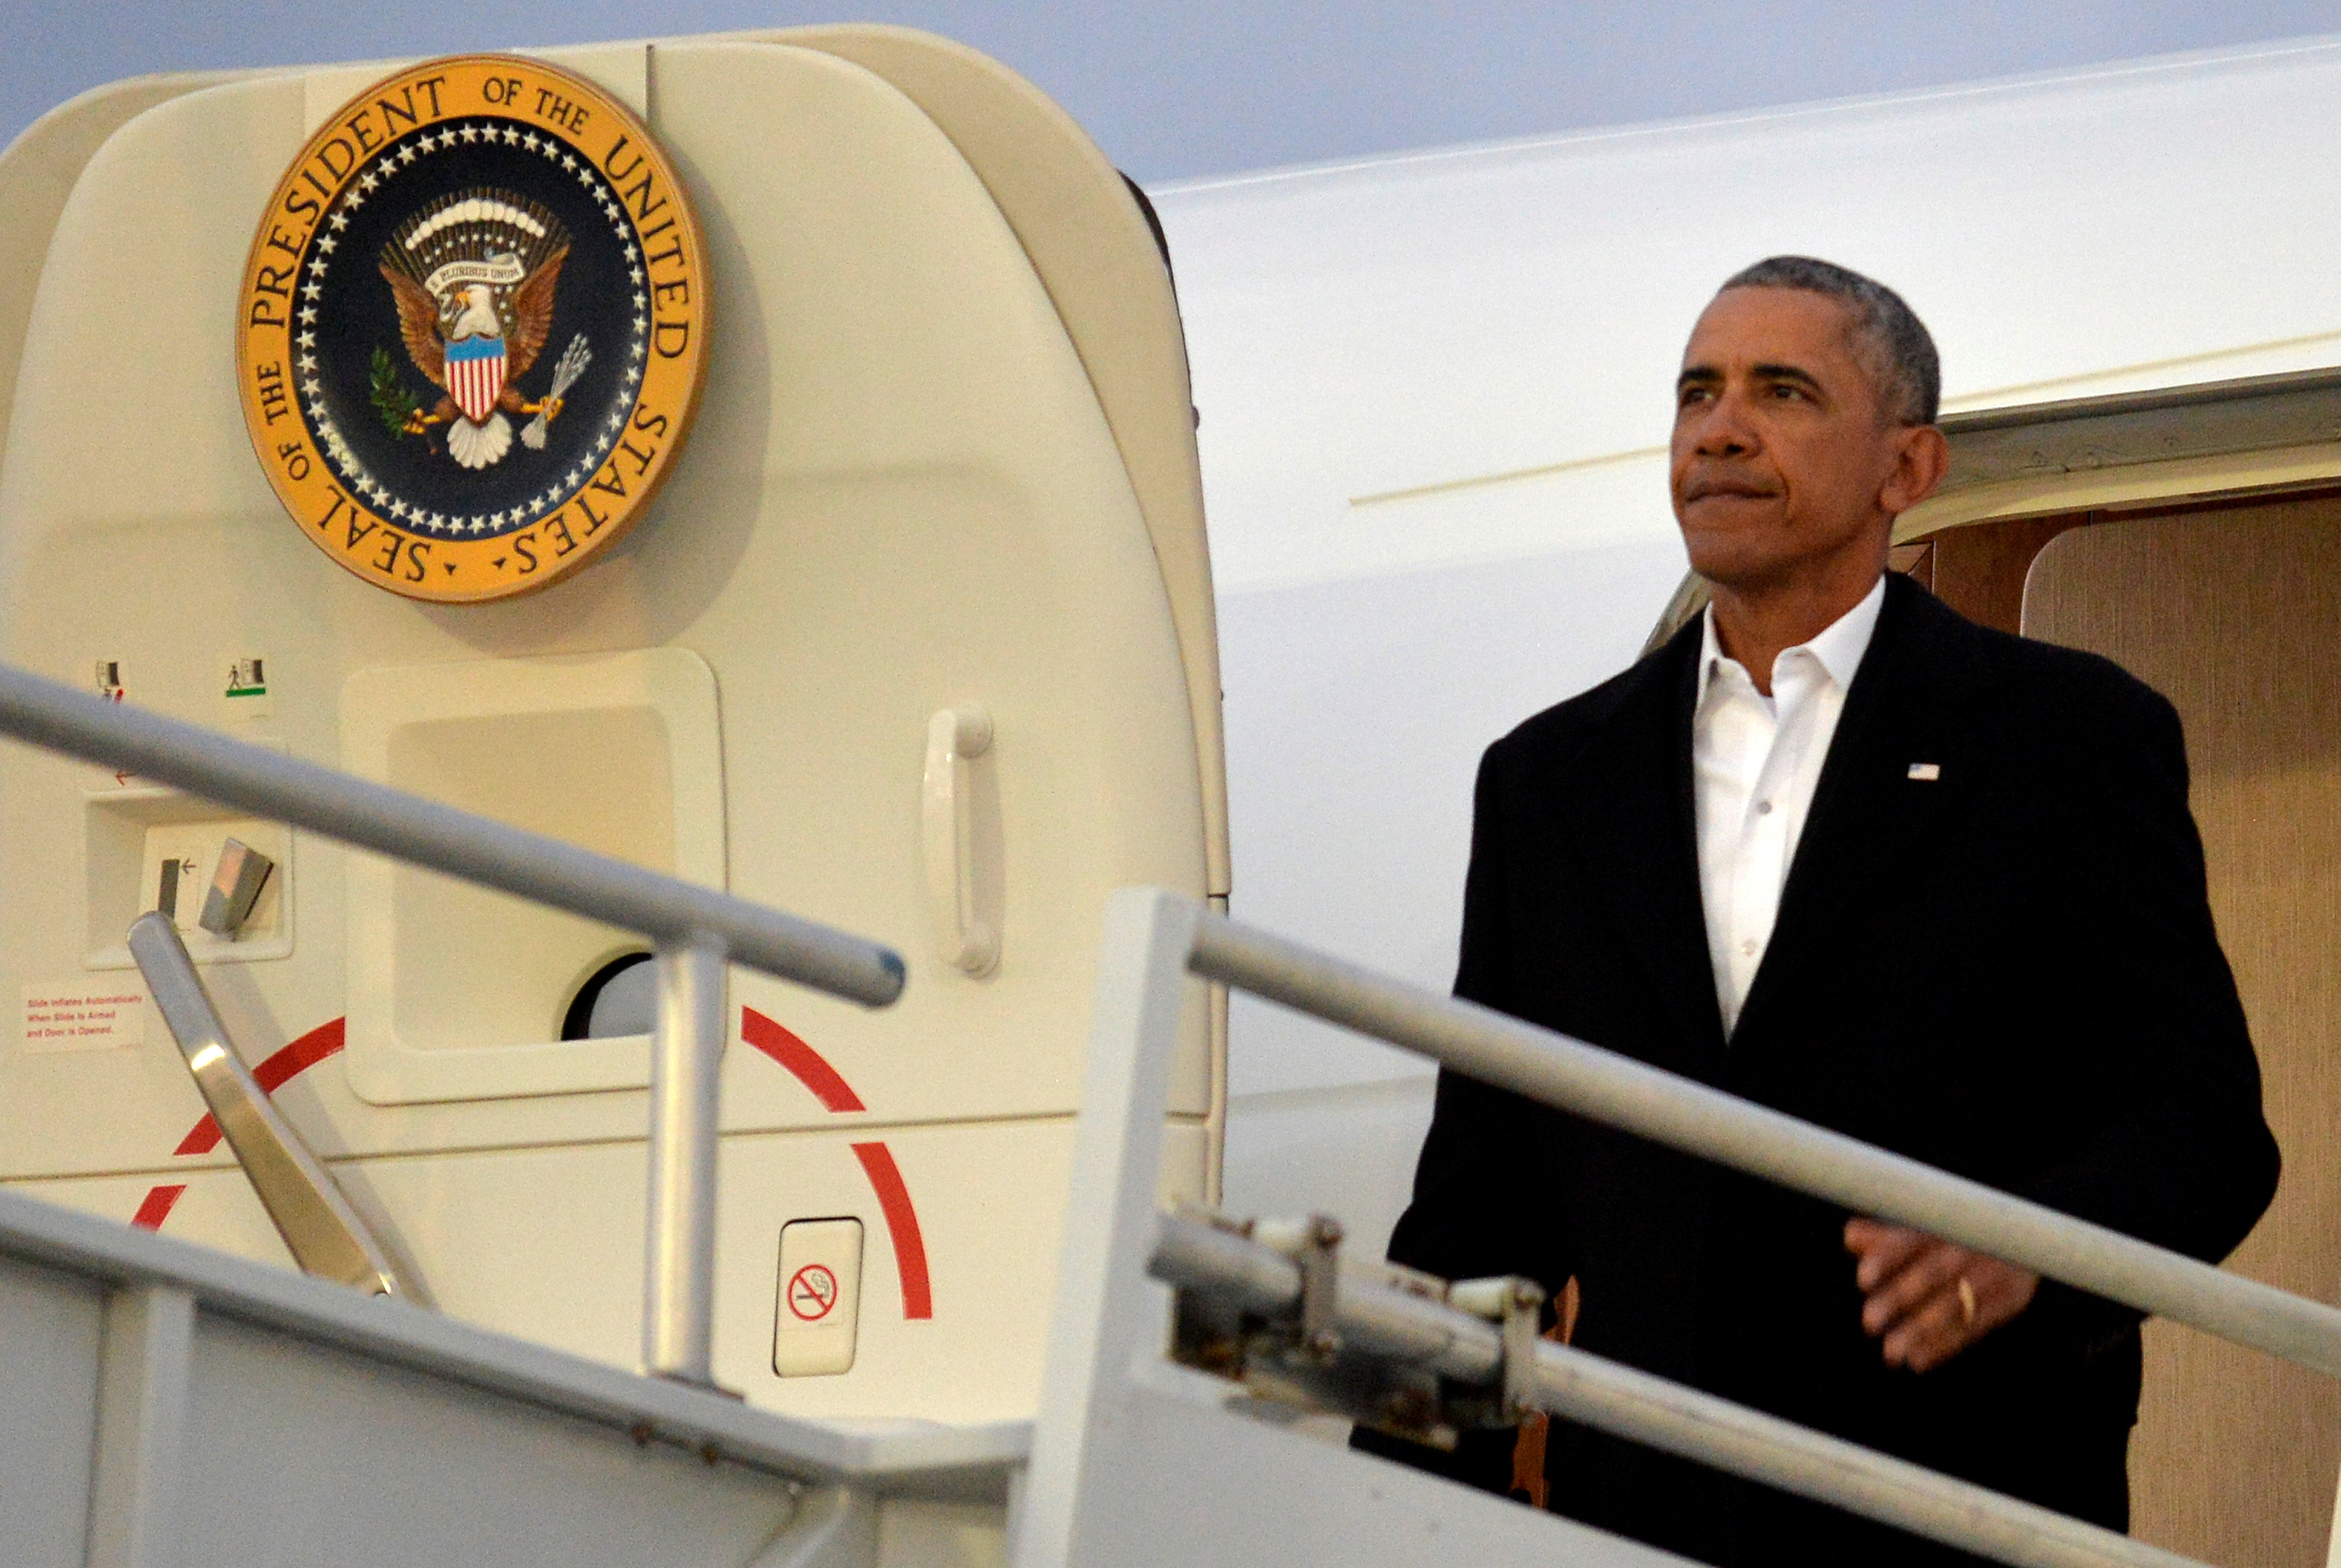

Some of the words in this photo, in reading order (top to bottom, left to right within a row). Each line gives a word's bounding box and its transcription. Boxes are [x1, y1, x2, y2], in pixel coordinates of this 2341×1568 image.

[482, 78, 522, 106] OF
[535, 89, 589, 136] THE
[250, 77, 446, 330] PRESIDENT
[603, 138, 690, 359] UNITED
[262, 360, 286, 427] THE
[277, 441, 310, 481] OF
[512, 403, 667, 576] STATES
[317, 484, 433, 582] SEAL
